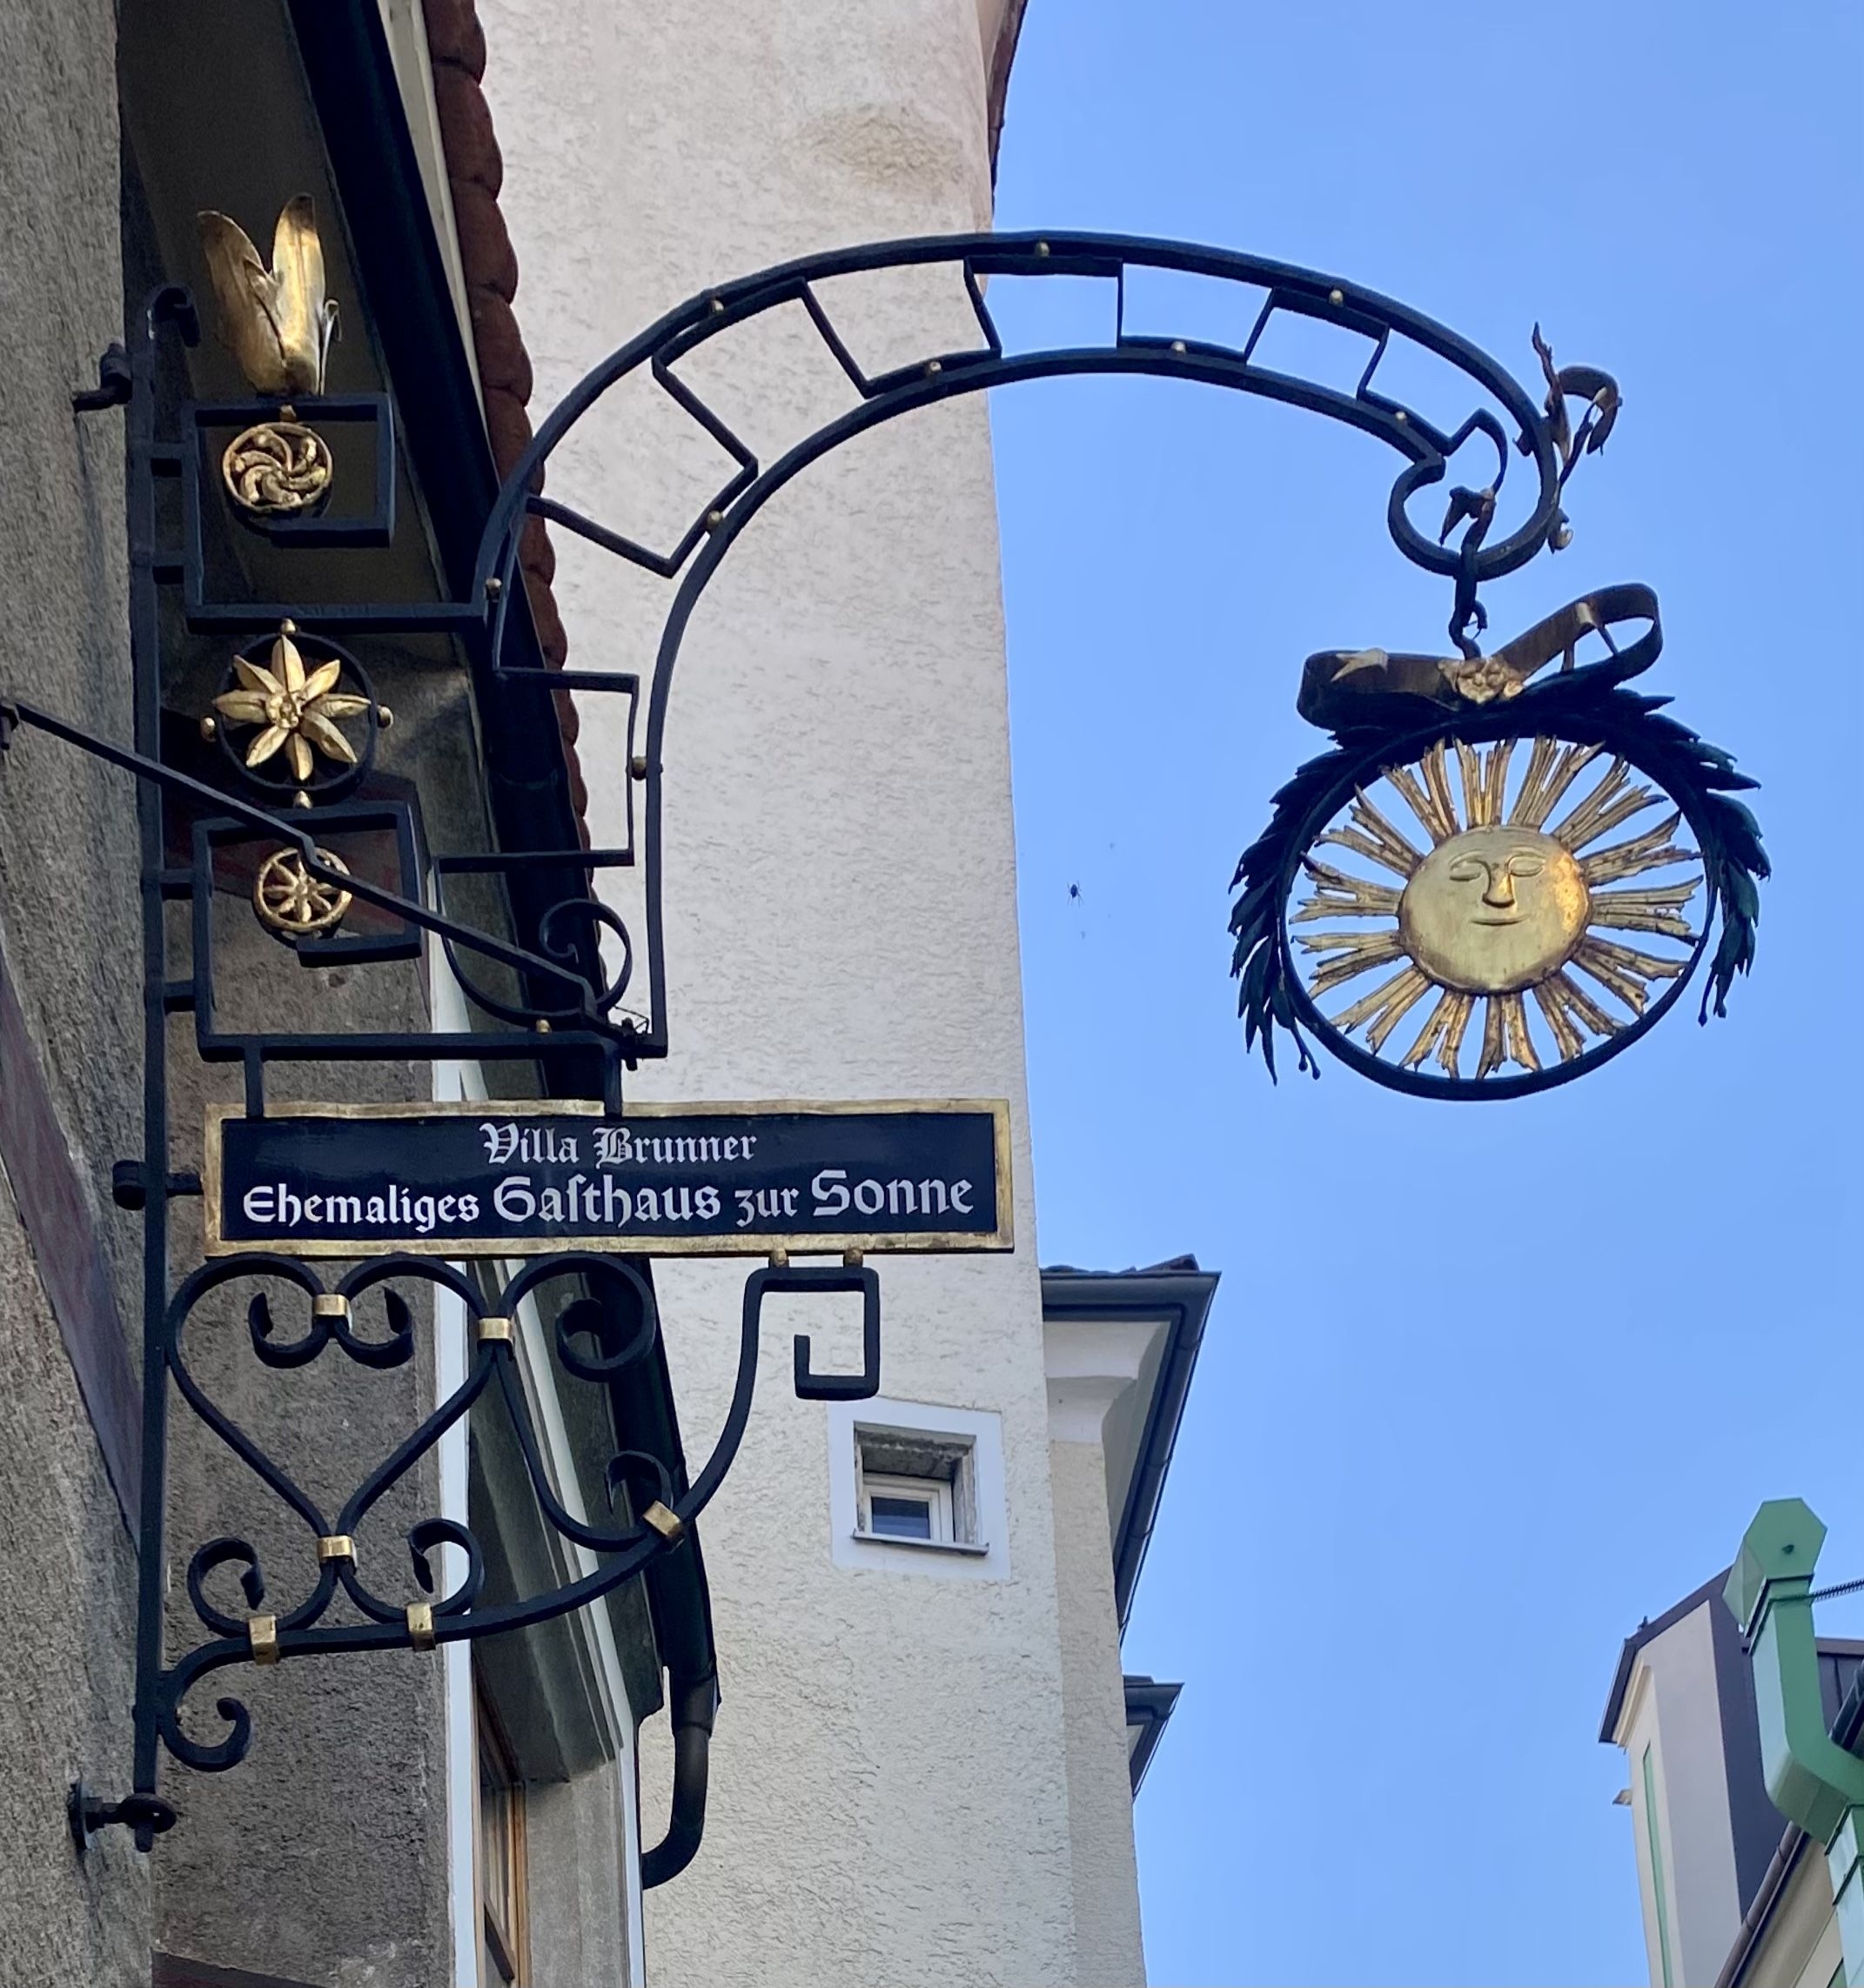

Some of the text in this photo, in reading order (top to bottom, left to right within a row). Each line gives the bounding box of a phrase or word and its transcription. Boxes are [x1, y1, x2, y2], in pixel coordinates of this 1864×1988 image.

[479, 1123, 758, 1170] Villa Brunner
[243, 1183, 480, 1233] Ehemaliges
[735, 1188, 800, 1228] zur
[812, 1169, 974, 1216] Sonne
